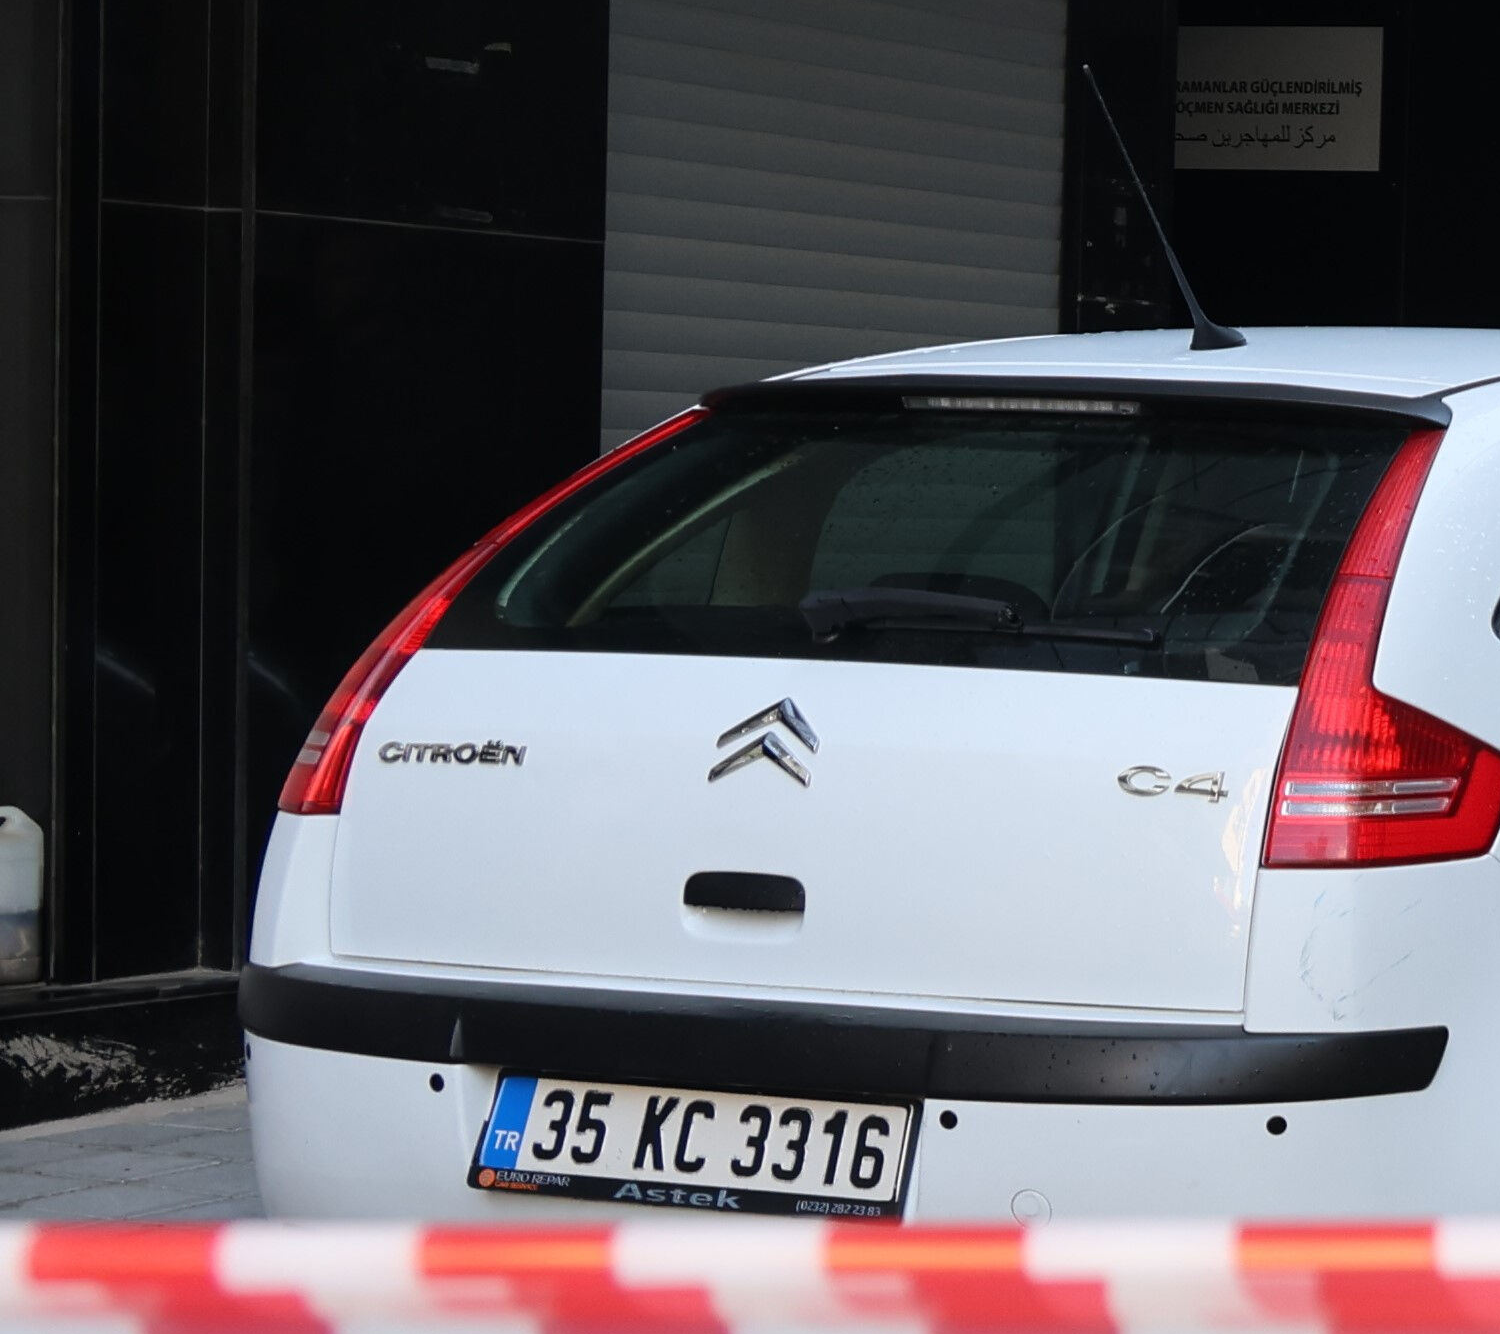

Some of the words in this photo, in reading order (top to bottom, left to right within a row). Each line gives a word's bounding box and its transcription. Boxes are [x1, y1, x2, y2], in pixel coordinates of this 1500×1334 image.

[1250, 78, 1363, 98] GÜÇLENDİRİLMİŞ
[1226, 99, 1279, 115] SAĞLIĞI
[1281, 100, 1341, 116] MERKEZİ
[1293, 125, 1337, 149] مركز
[378, 739, 528, 767] CITROËN
[1117, 765, 1229, 804] C4
[493, 1130, 522, 1152] TR
[532, 1089, 614, 1164] 35
[633, 1095, 715, 1173] KC
[731, 1104, 890, 1190] 3316
[496, 1170, 530, 1183] EURO
[531, 1173, 570, 1187] REPAR
[613, 1182, 742, 1210] Astek
[795, 1200, 830, 1215] (0232)
[852, 1204, 865, 1216] 23
